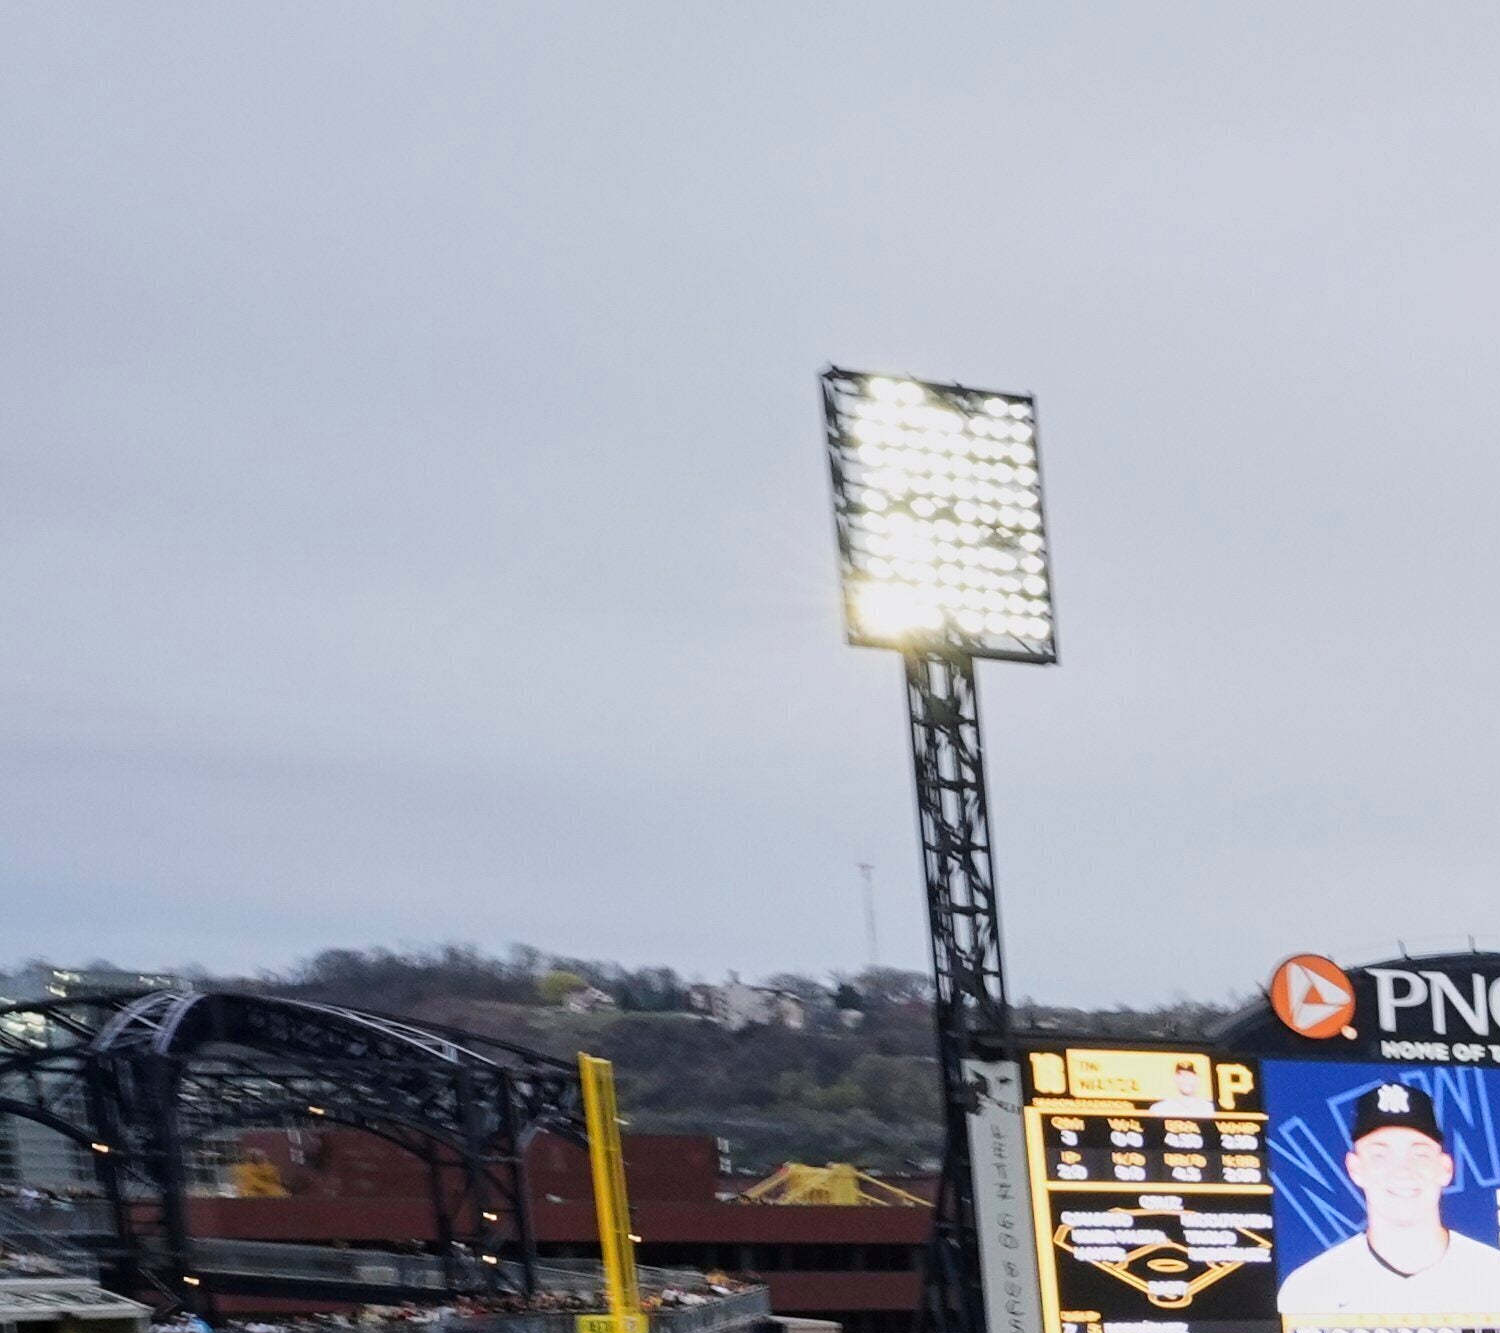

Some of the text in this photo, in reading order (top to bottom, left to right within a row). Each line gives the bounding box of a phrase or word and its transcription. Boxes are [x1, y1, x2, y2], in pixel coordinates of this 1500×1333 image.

[1380, 1040, 1449, 1062] HOME
[1450, 1042, 1486, 1063] OF
[1215, 1063, 1254, 1110] P
